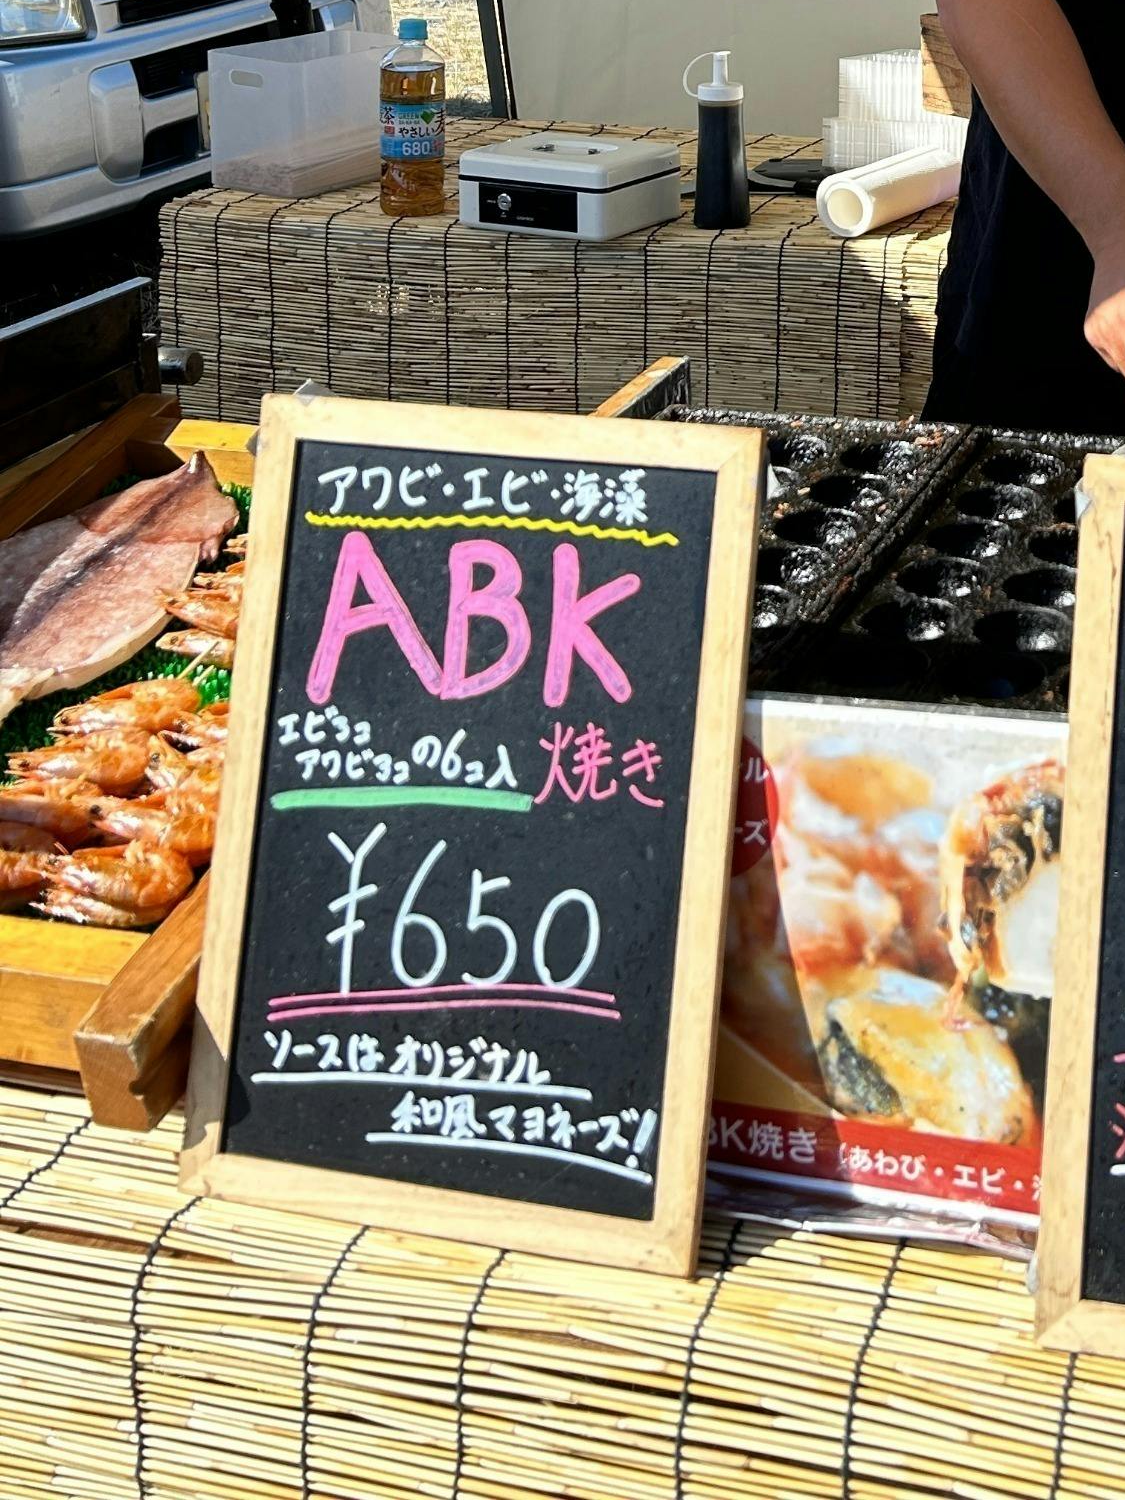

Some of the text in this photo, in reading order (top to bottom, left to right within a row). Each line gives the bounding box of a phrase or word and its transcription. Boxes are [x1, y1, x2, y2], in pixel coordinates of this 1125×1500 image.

[399, 126, 435, 138] やさしい
[402, 141, 431, 156] 680
[305, 530, 643, 707] ABK
[532, 720, 664, 808] 焼き
[324, 821, 601, 994] ¥650
